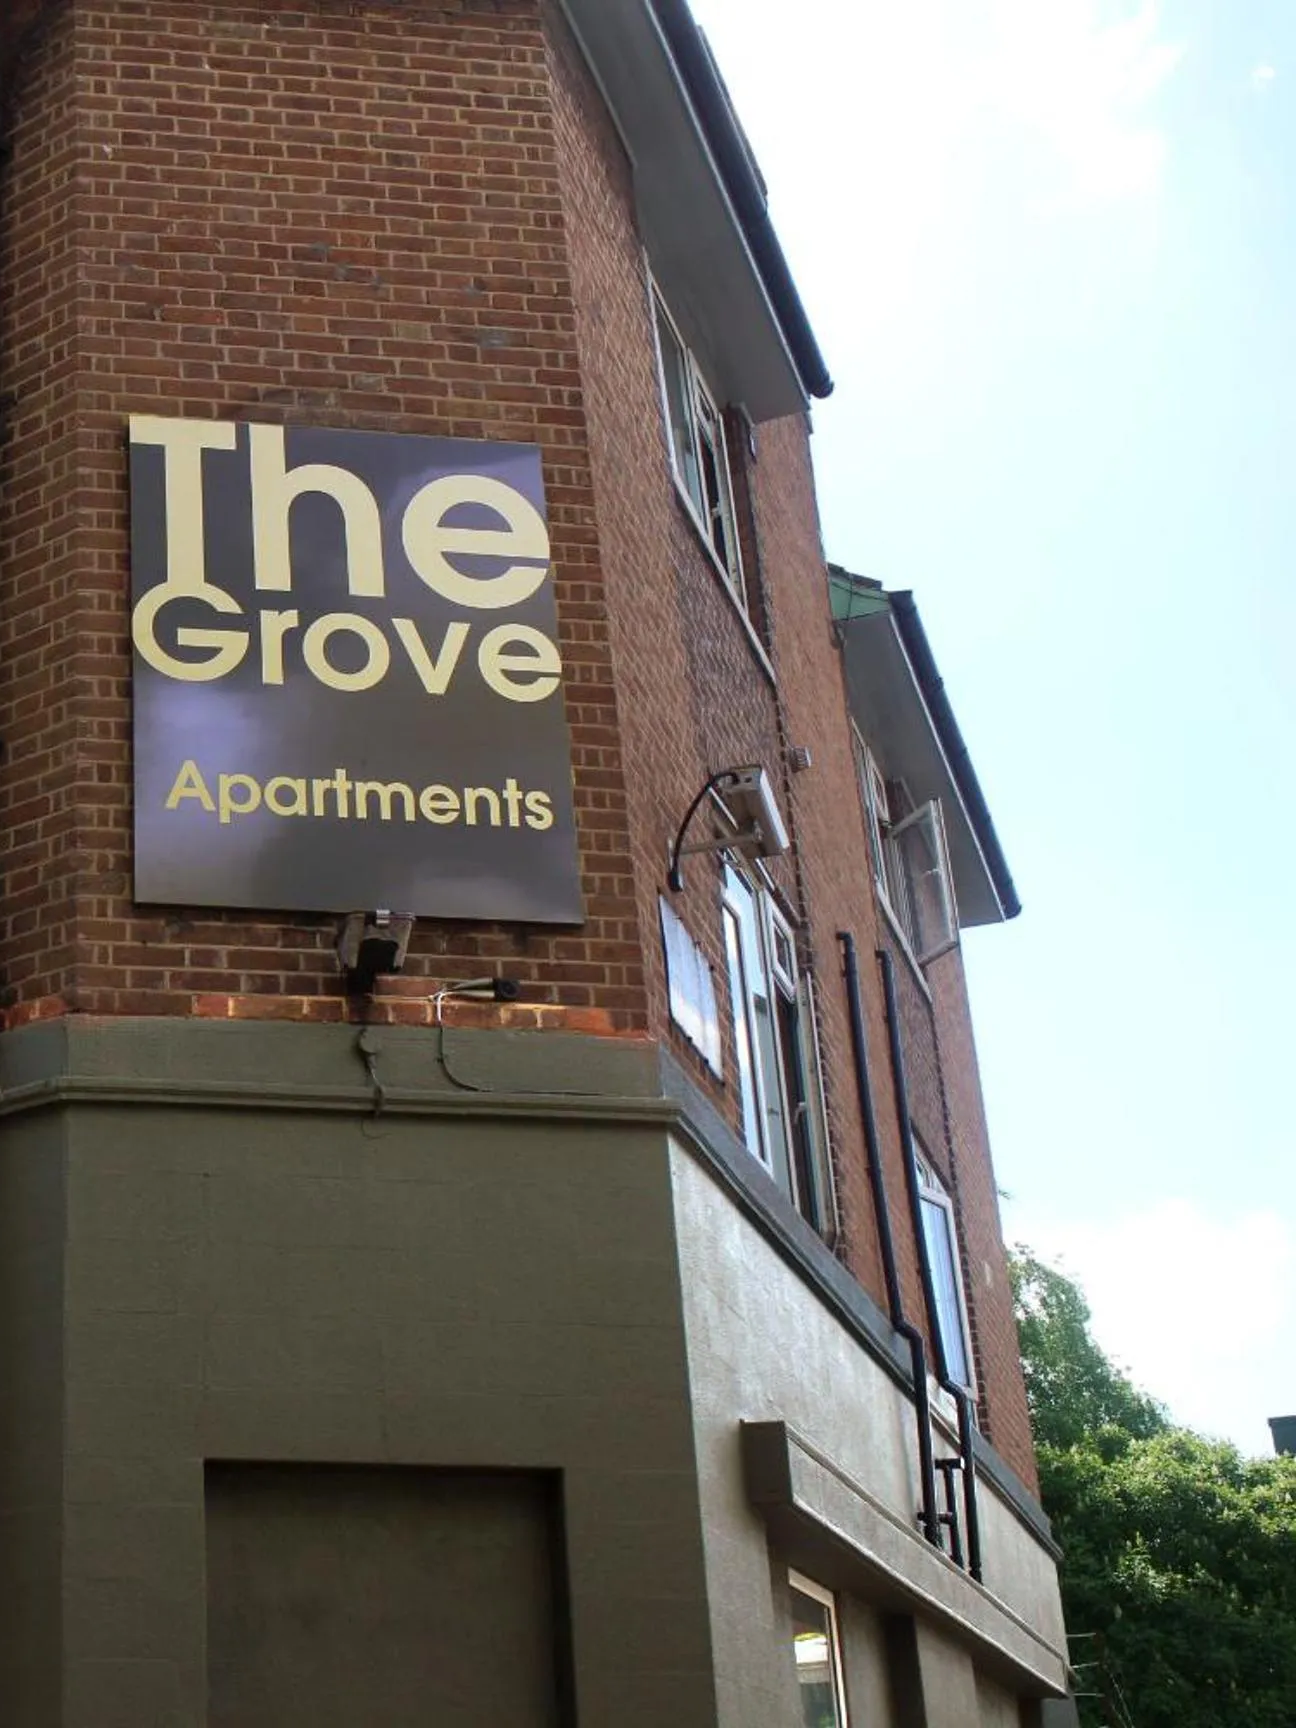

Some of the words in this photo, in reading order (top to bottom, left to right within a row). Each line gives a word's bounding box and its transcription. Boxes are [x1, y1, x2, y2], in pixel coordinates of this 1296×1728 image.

[129, 415, 551, 609] The
[132, 580, 563, 703] Grove
[165, 759, 554, 831] Apartments
